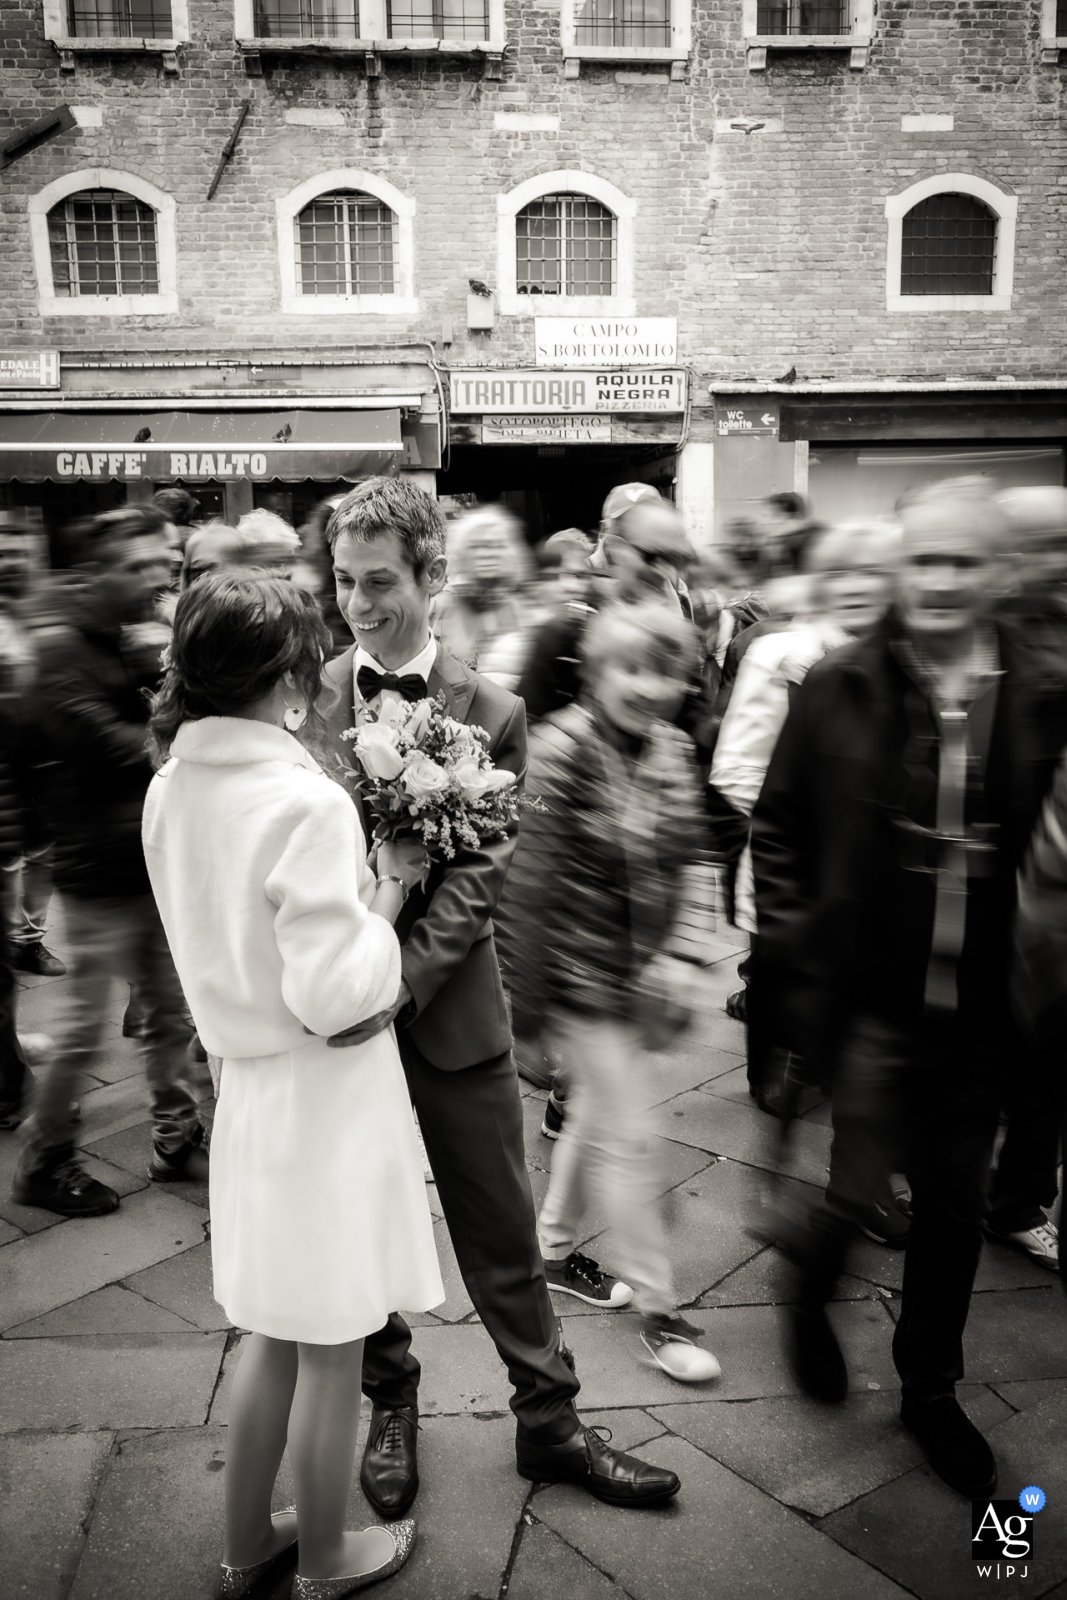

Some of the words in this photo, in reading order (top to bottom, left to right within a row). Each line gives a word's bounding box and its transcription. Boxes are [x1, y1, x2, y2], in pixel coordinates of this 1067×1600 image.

[573, 323, 638, 337] CAMPO
[40, 353, 56, 386] H
[596, 375, 673, 387] AQUILA
[461, 380, 586, 406] TRATTORIA
[598, 389, 670, 400] NEGRA
[595, 401, 667, 410] PIZZERIA
[726, 410, 745, 420] WC
[718, 419, 753, 429] toilette
[56, 453, 147, 475] CAFFE'
[170, 453, 267, 475] RIALTO
